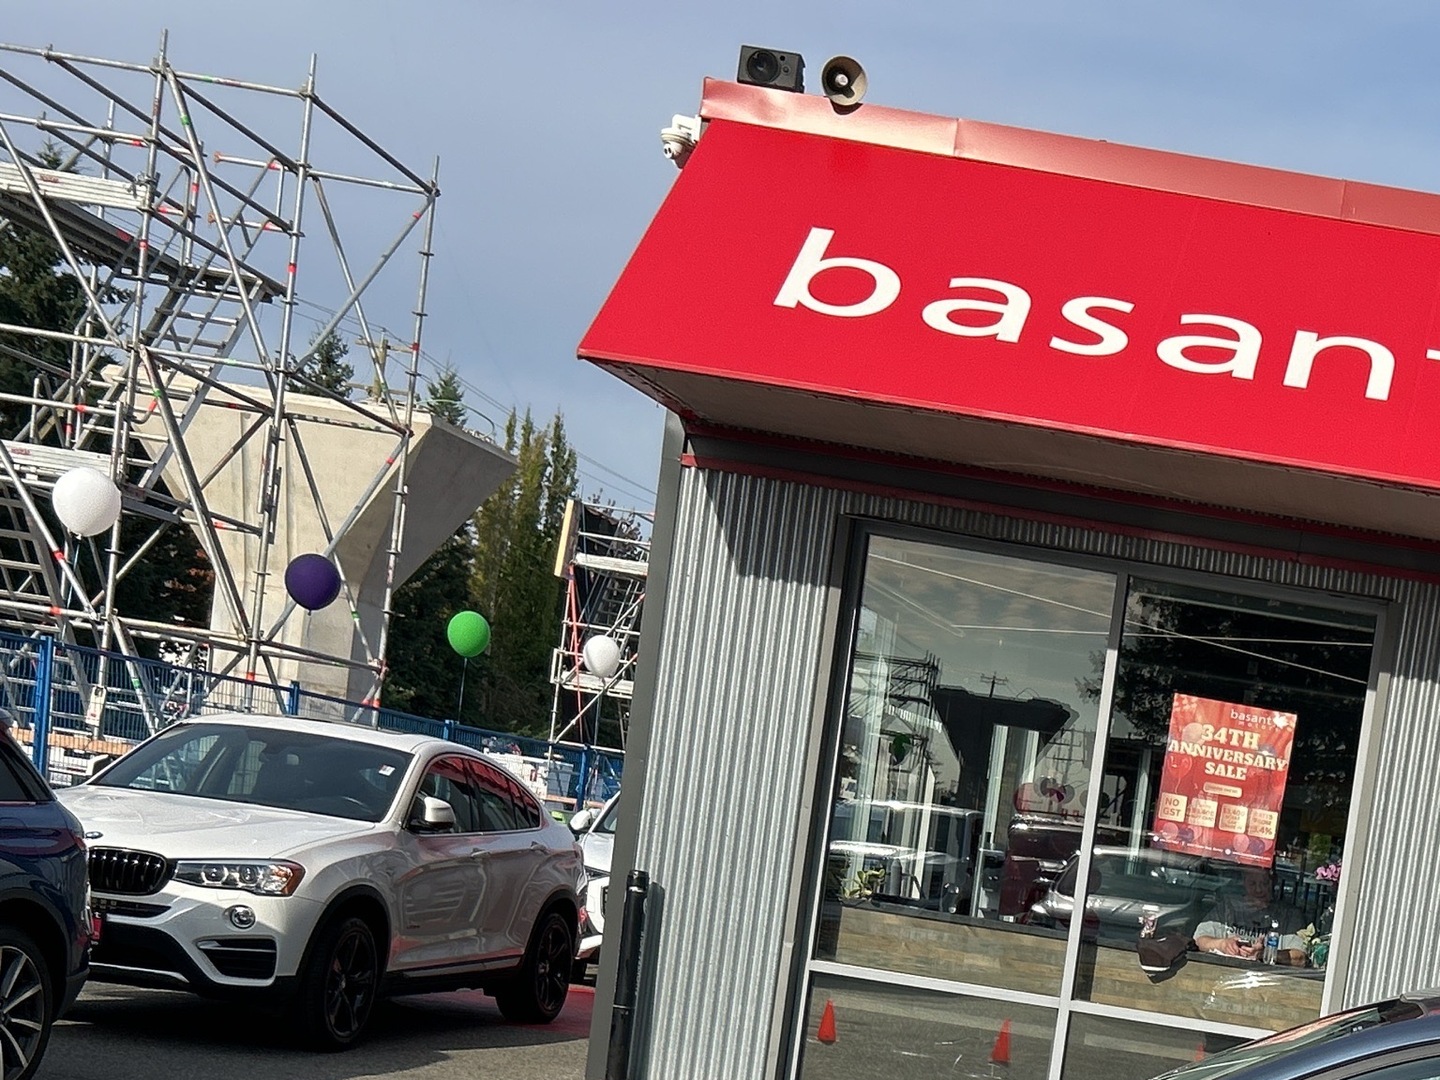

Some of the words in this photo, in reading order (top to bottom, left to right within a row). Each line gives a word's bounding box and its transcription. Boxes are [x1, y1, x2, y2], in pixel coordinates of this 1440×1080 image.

[1230, 709, 1272, 726] basant
[1201, 724, 1260, 750] 34TH
[1167, 740, 1288, 772] ANNIVERSARY
[1204, 761, 1247, 781] SALE
[1165, 797, 1180, 807] NO
[1162, 806, 1181, 817] GST
